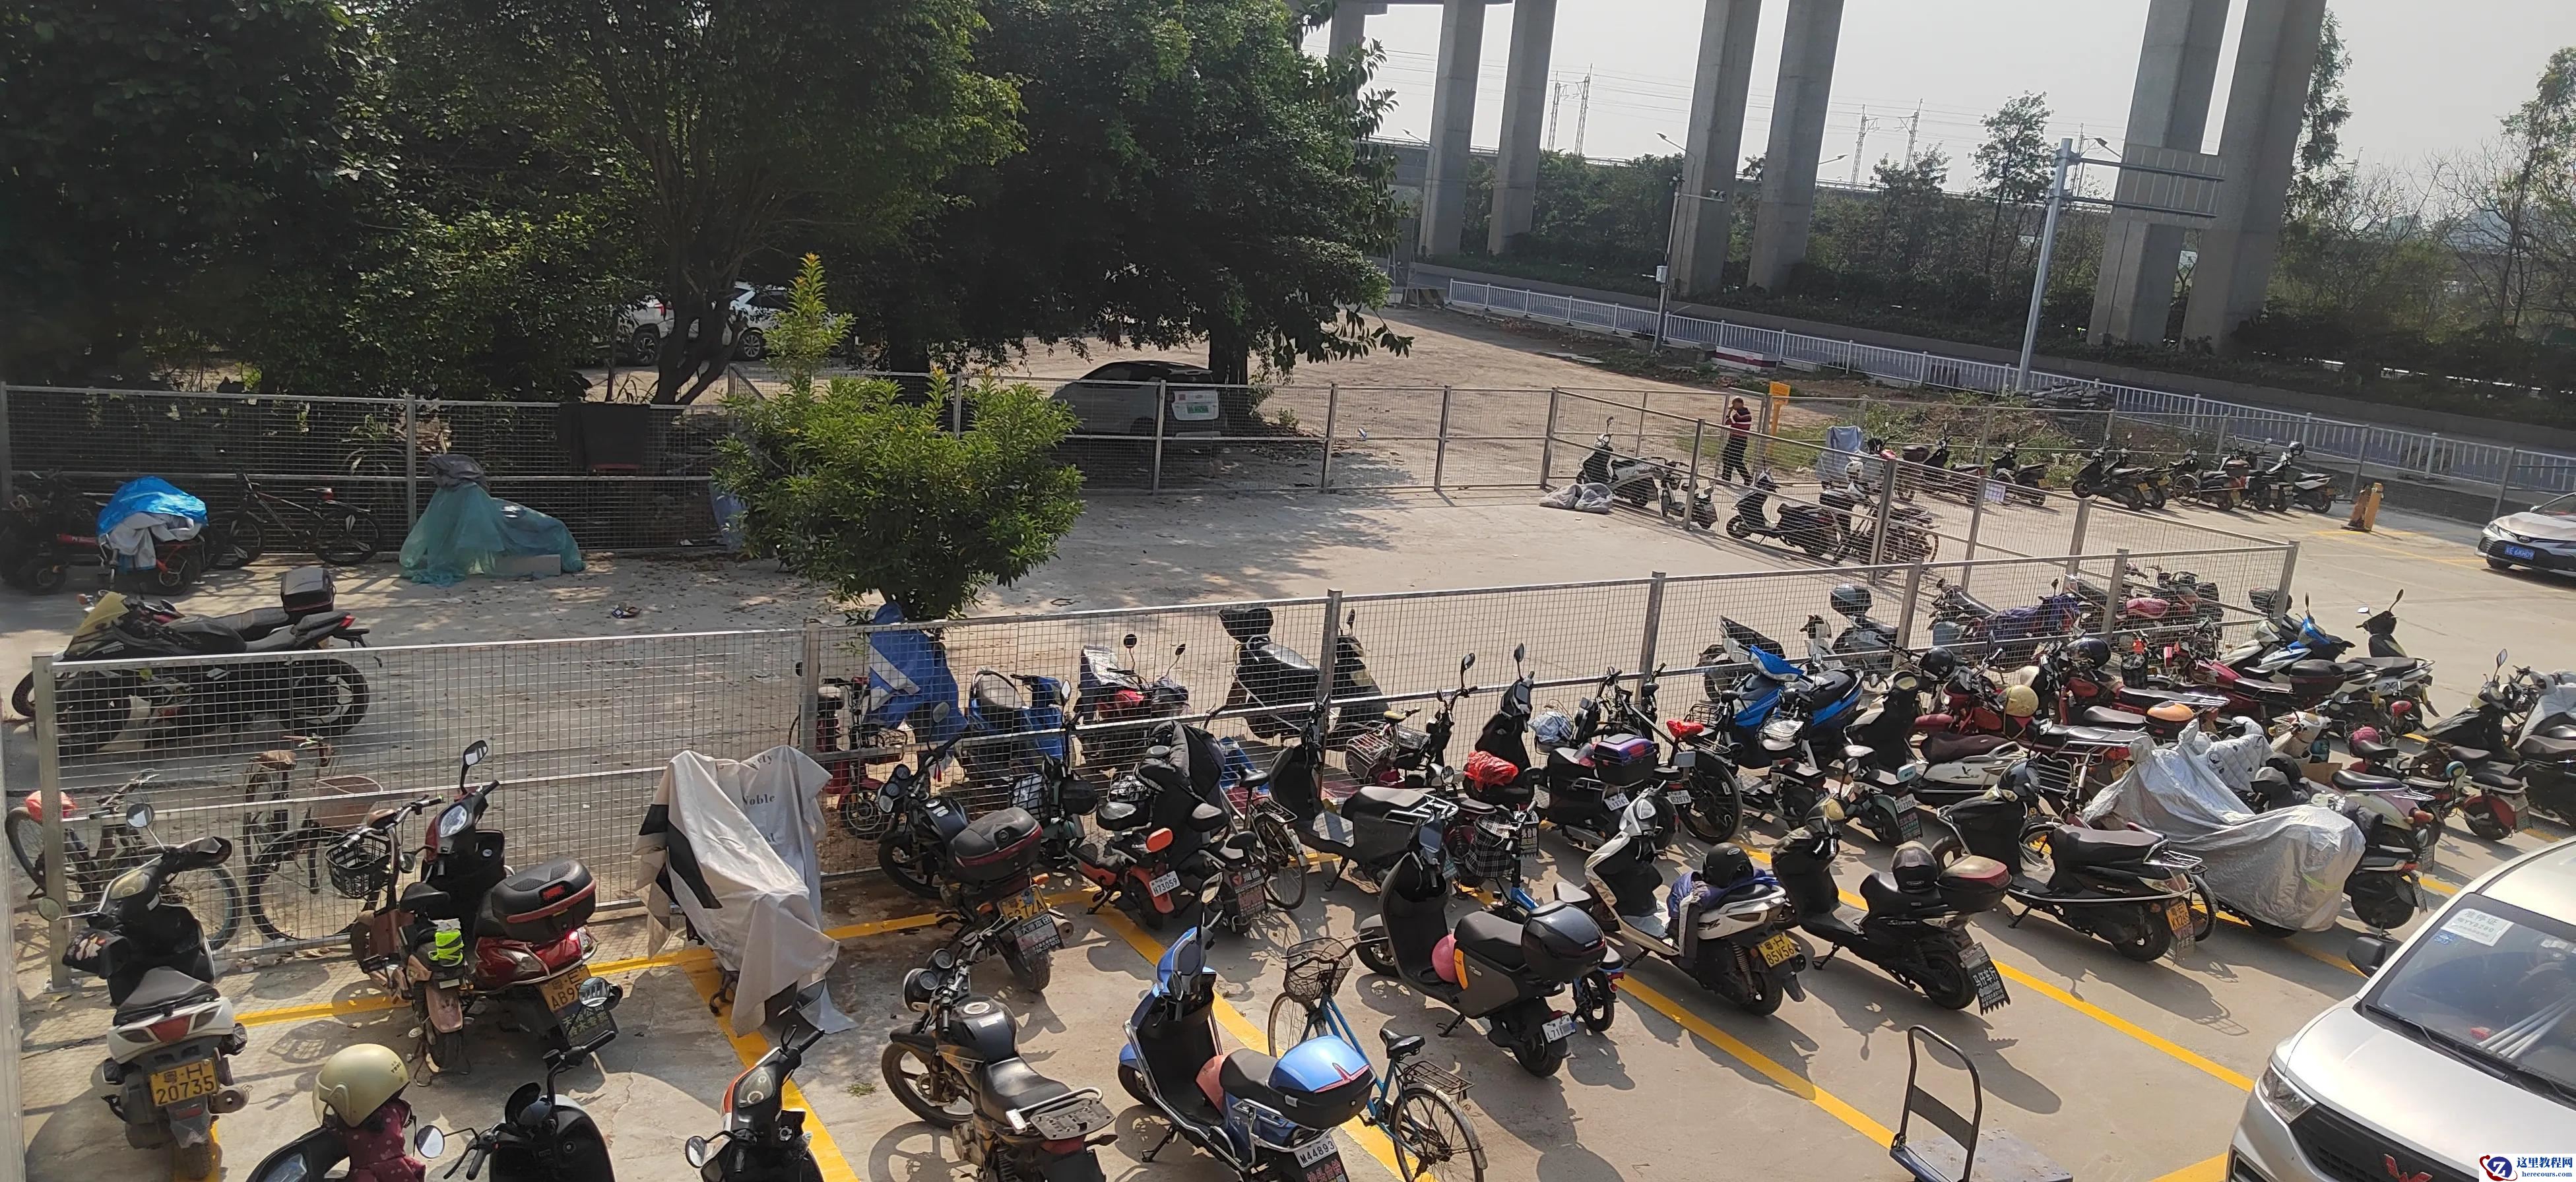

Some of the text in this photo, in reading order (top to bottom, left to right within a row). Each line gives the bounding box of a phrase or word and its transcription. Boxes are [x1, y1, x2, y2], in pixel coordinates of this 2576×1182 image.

[743, 793, 775, 805] Noble
[1766, 944, 1795, 964] 85V56
[156, 1075, 214, 1105] 20735
[1299, 1140, 1335, 1164] M44893
